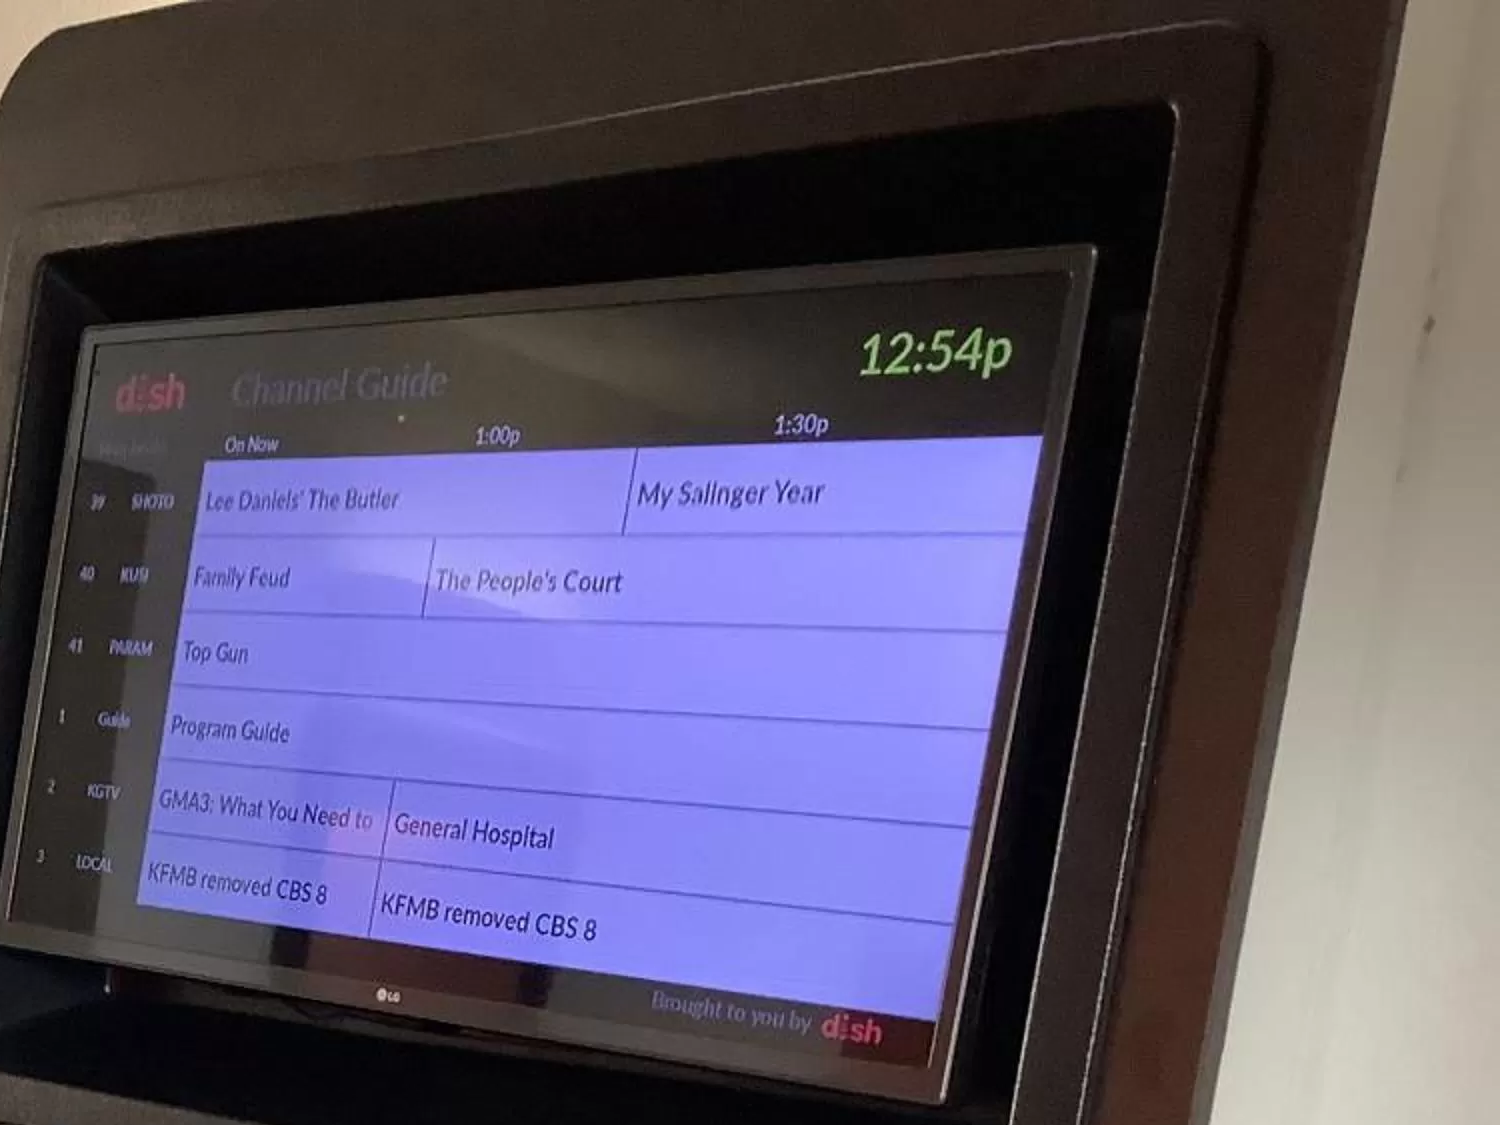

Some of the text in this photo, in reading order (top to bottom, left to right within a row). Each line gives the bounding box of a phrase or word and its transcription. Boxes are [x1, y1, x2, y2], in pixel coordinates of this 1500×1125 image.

[860, 327, 1013, 380] 12:54p
[233, 360, 448, 407] Channel Guide
[476, 425, 521, 448] 1:00p
[774, 413, 829, 437] 1:30p
[225, 436, 279, 453] On Now
[206, 489, 399, 511] Lee Daniels' The Butler
[638, 480, 825, 510] My Salinger Year
[194, 566, 291, 589] Family Feud
[436, 568, 624, 597] The People's Court
[109, 639, 153, 656] PARAM
[184, 640, 249, 666] Top Gun
[98, 710, 131, 728] Guide
[171, 715, 290, 744] Program Guide
[87, 783, 121, 800] KGTV
[159, 789, 373, 830] GMA3: What You Need to
[395, 812, 555, 851] General Hospital
[76, 854, 113, 873] LOCAL
[147, 861, 327, 906] KFMB removed CBS 8
[381, 892, 597, 942] KFMB removed CBS 8
[651, 989, 722, 1020] Brought
[726, 1003, 747, 1022] to
[750, 1010, 785, 1032] you
[788, 1009, 813, 1036] by
